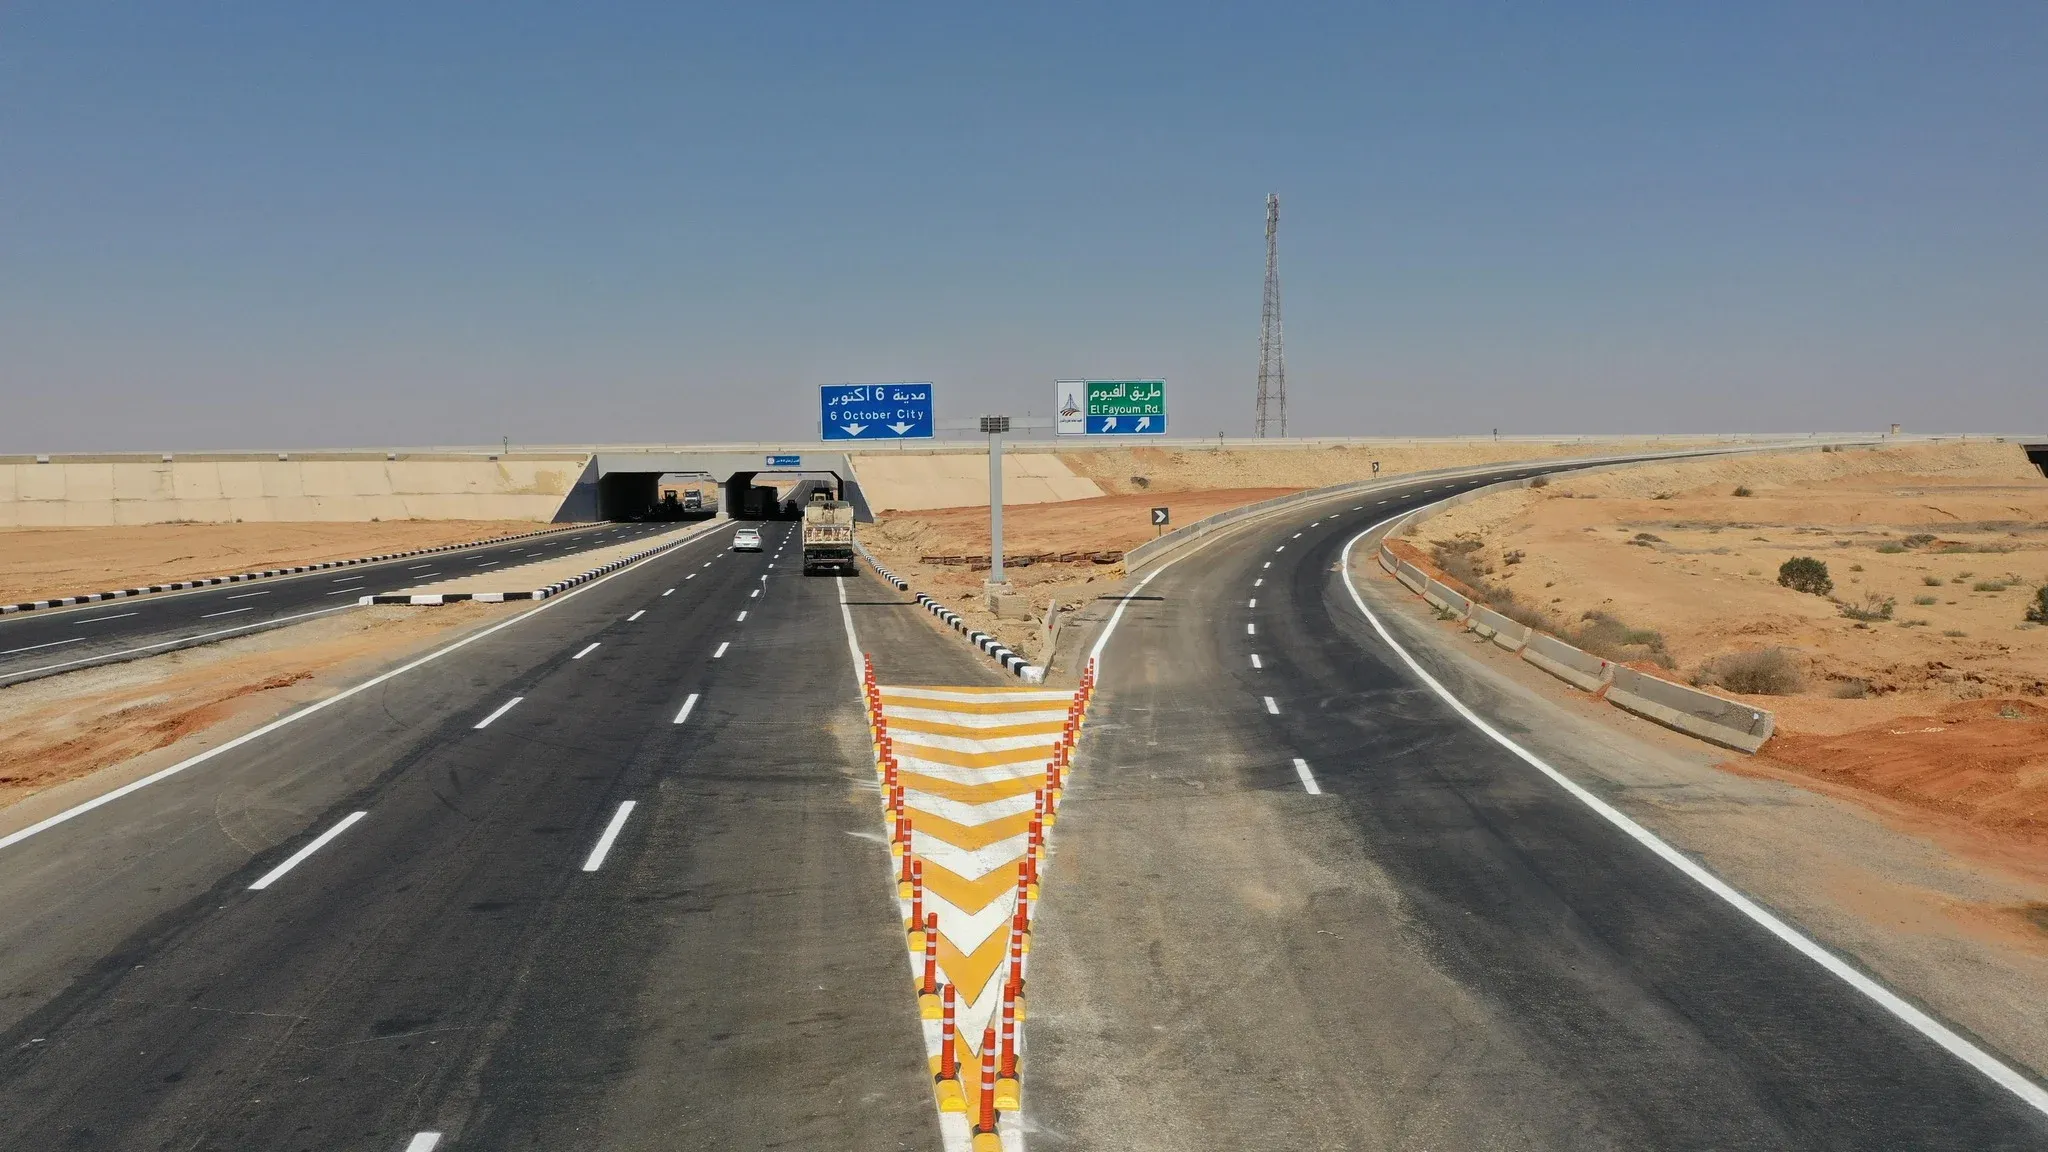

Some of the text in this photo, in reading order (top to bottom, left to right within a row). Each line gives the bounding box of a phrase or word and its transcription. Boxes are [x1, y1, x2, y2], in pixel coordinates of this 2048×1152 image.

[875, 387, 885, 401] 6
[893, 388, 926, 404] مدينة
[1090, 383, 1160, 401] طريق الفيوم
[830, 409, 924, 421] 6 October City
[1090, 404, 1160, 416] El Fayoum Rd.
